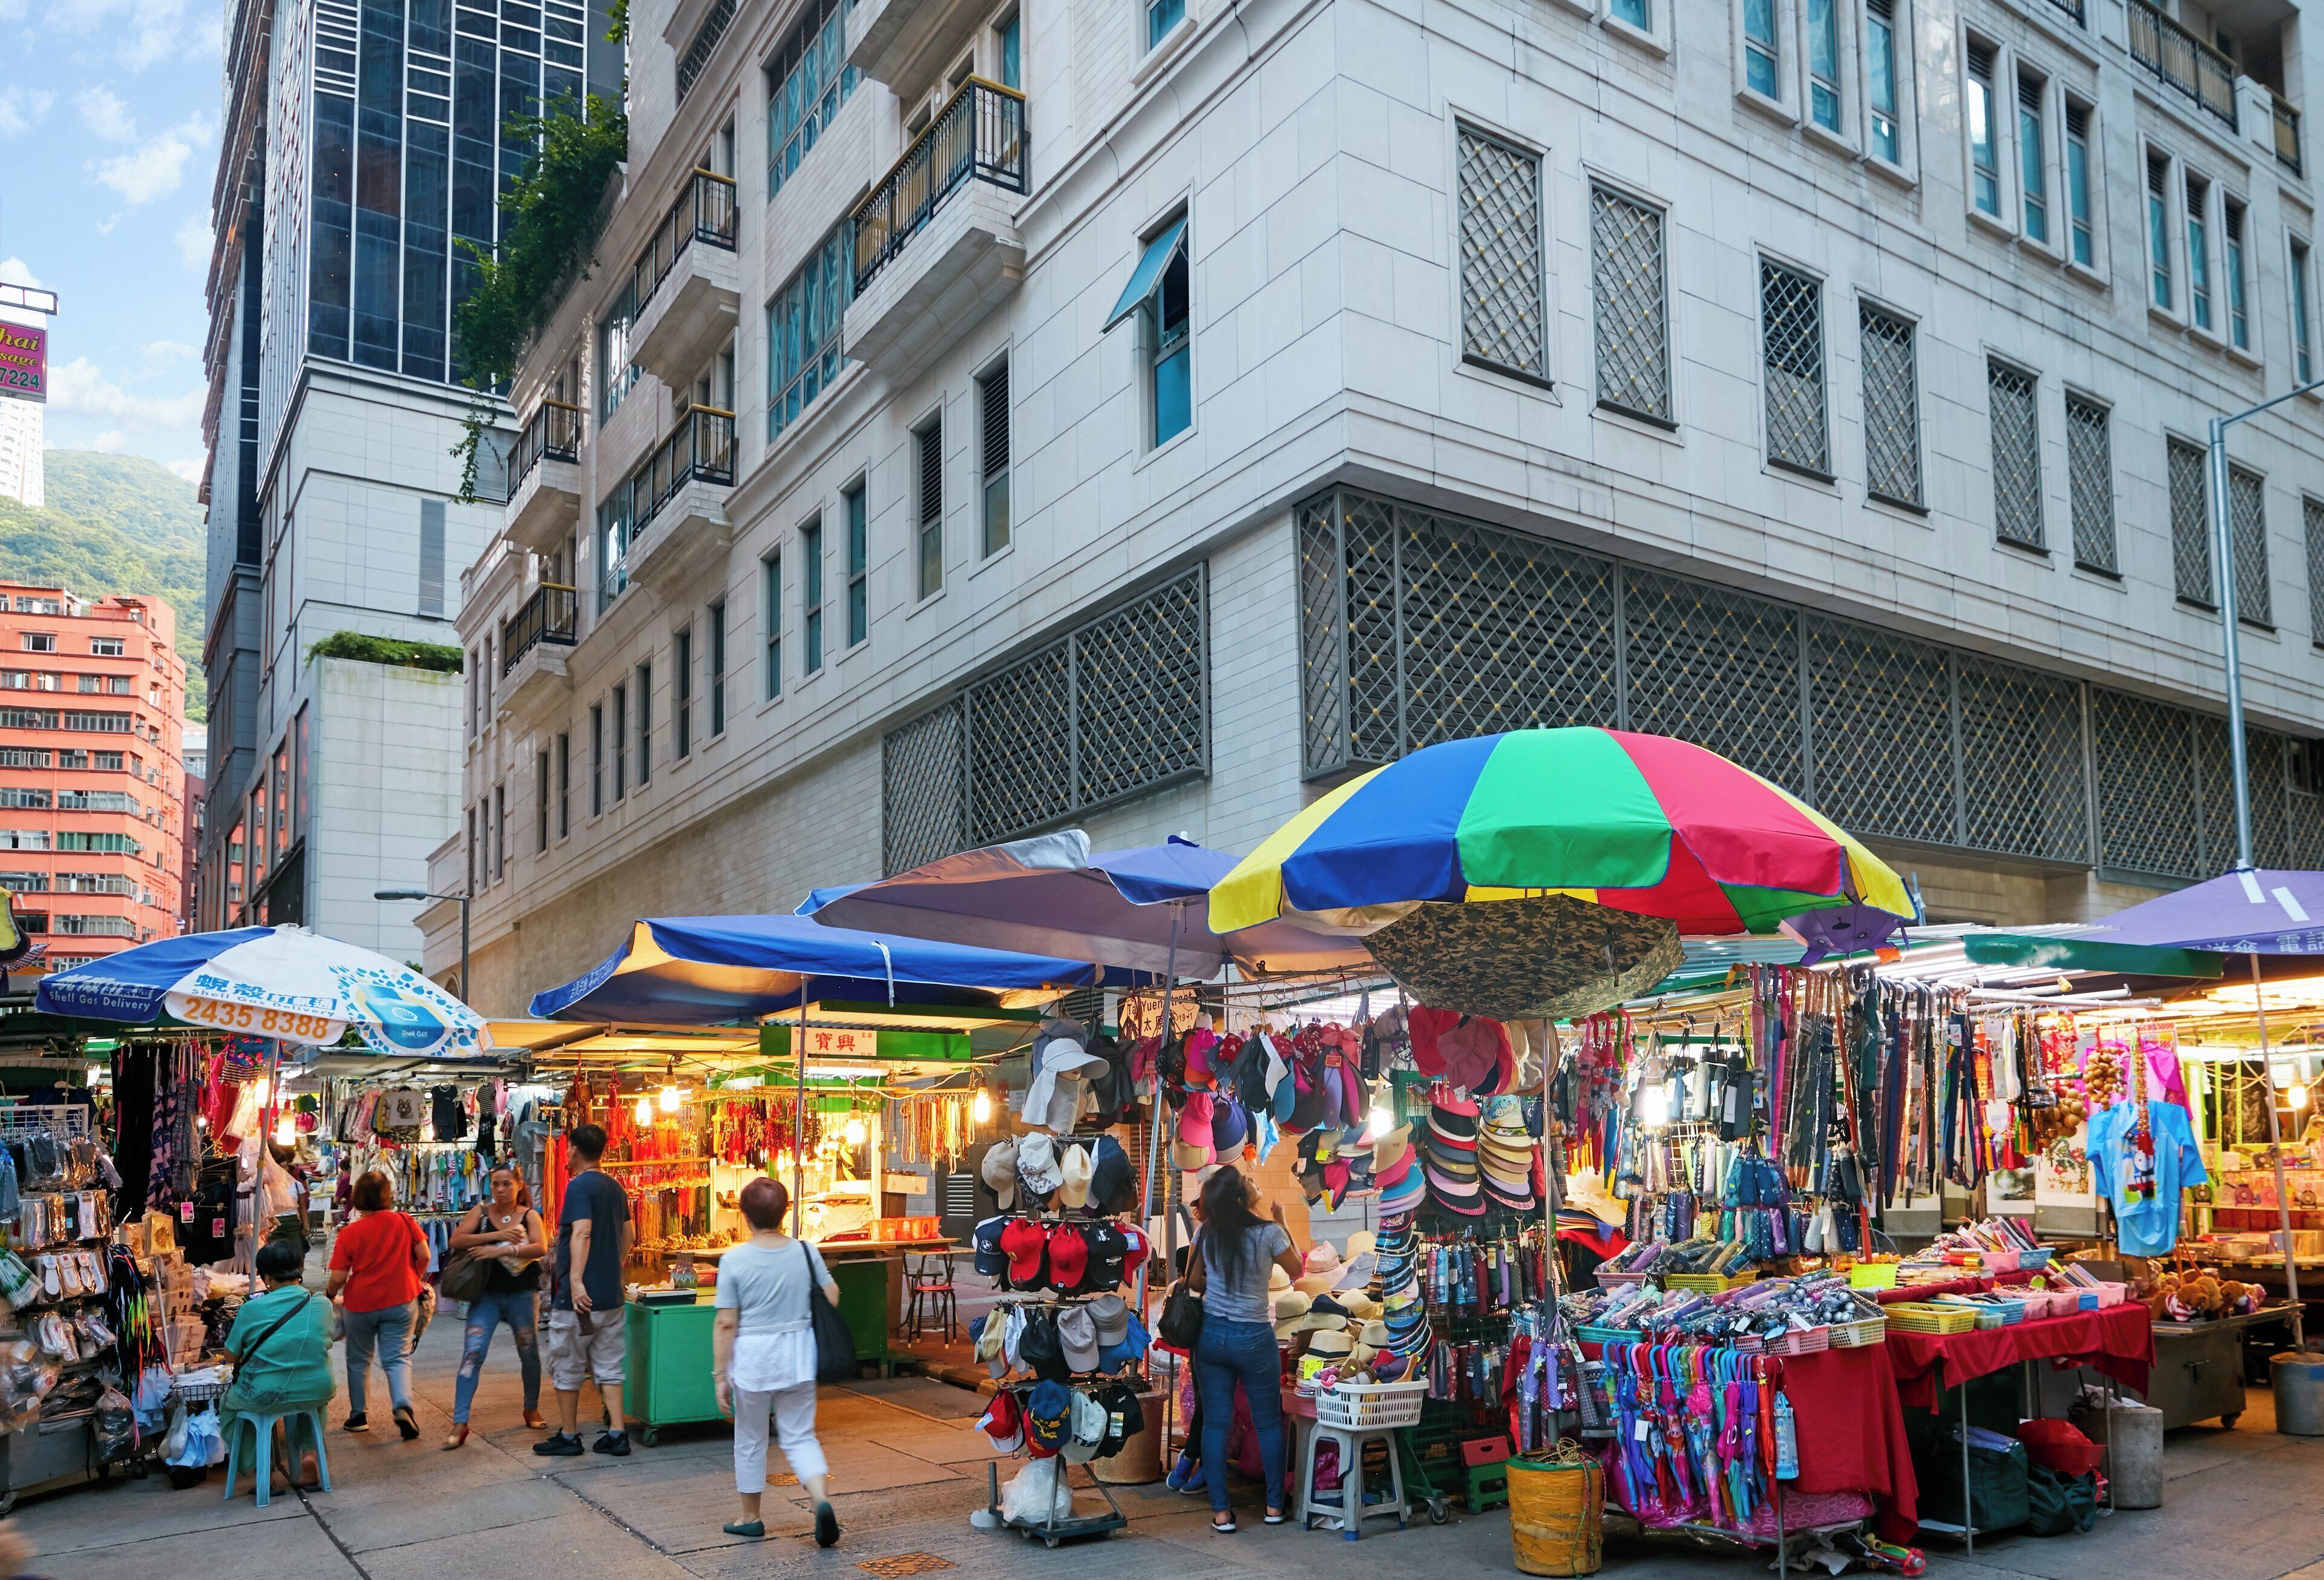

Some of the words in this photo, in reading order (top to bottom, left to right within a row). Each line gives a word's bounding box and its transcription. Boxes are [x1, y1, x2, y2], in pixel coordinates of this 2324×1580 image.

[49, 990, 74, 1002] Shell
[79, 994, 98, 1005] Gas
[102, 997, 151, 1012] Delivery
[191, 988, 229, 999] Shell
[237, 996, 265, 1005] Gas
[273, 1002, 335, 1017] Delivery
[1128, 1003, 1138, 1015] Ta
[1141, 999, 1163, 1012] Yuen
[1171, 991, 1192, 1006] treet
[183, 998, 254, 1027] 2435
[261, 1009, 329, 1039] 8388
